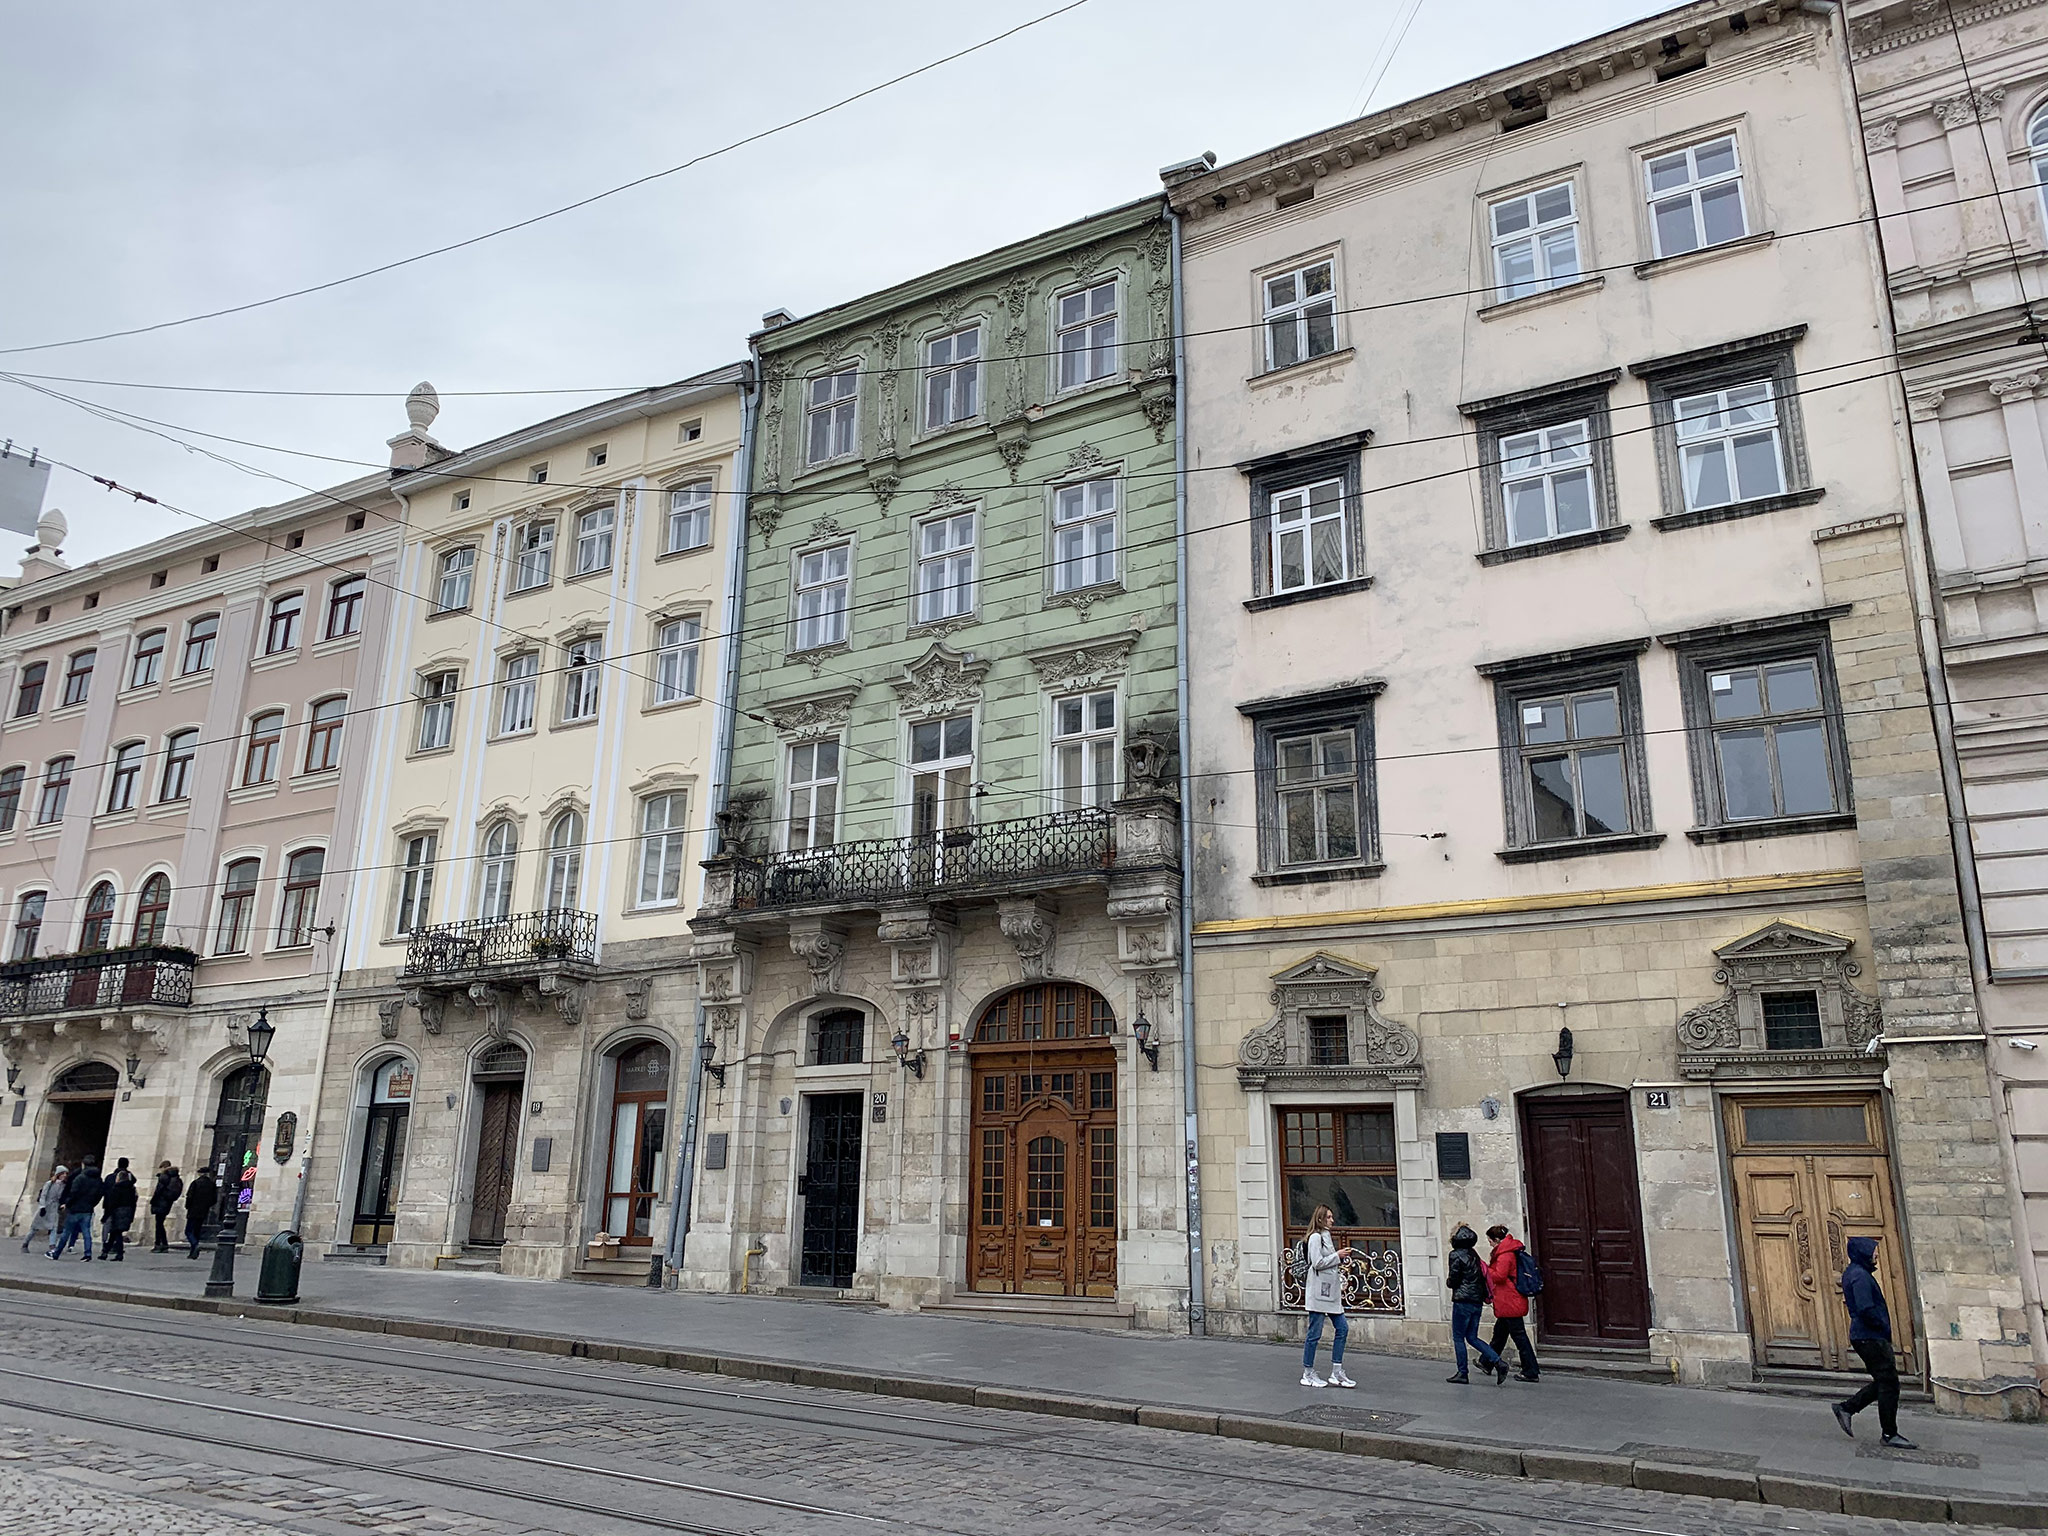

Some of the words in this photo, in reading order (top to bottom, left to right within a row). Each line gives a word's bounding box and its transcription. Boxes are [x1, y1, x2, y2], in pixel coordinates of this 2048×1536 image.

[874, 1093, 885, 1104] 20
[1649, 1092, 1666, 1106] 21
[532, 1102, 541, 1111] 19
